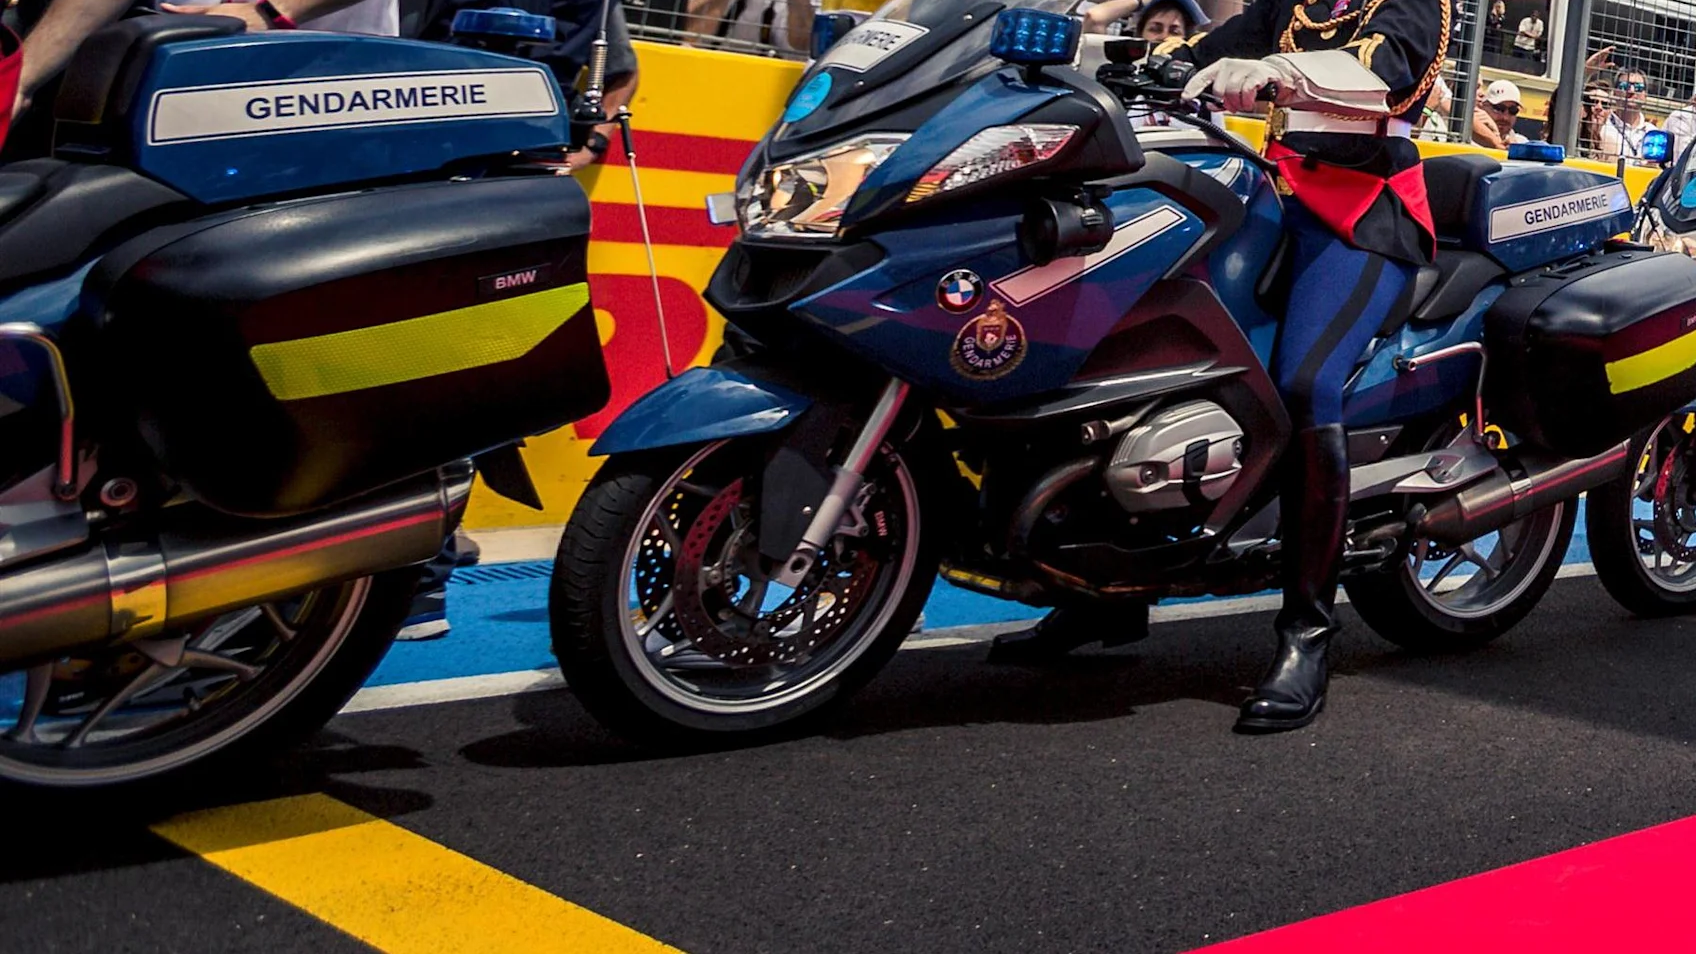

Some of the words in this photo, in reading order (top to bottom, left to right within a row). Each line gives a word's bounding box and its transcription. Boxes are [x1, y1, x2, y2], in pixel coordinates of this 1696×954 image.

[245, 83, 487, 120] GENDARMERIE
[1524, 194, 1608, 226] GENDARMERIE
[495, 269, 537, 290] BMW
[962, 334, 1017, 368] GENDARMERIE
